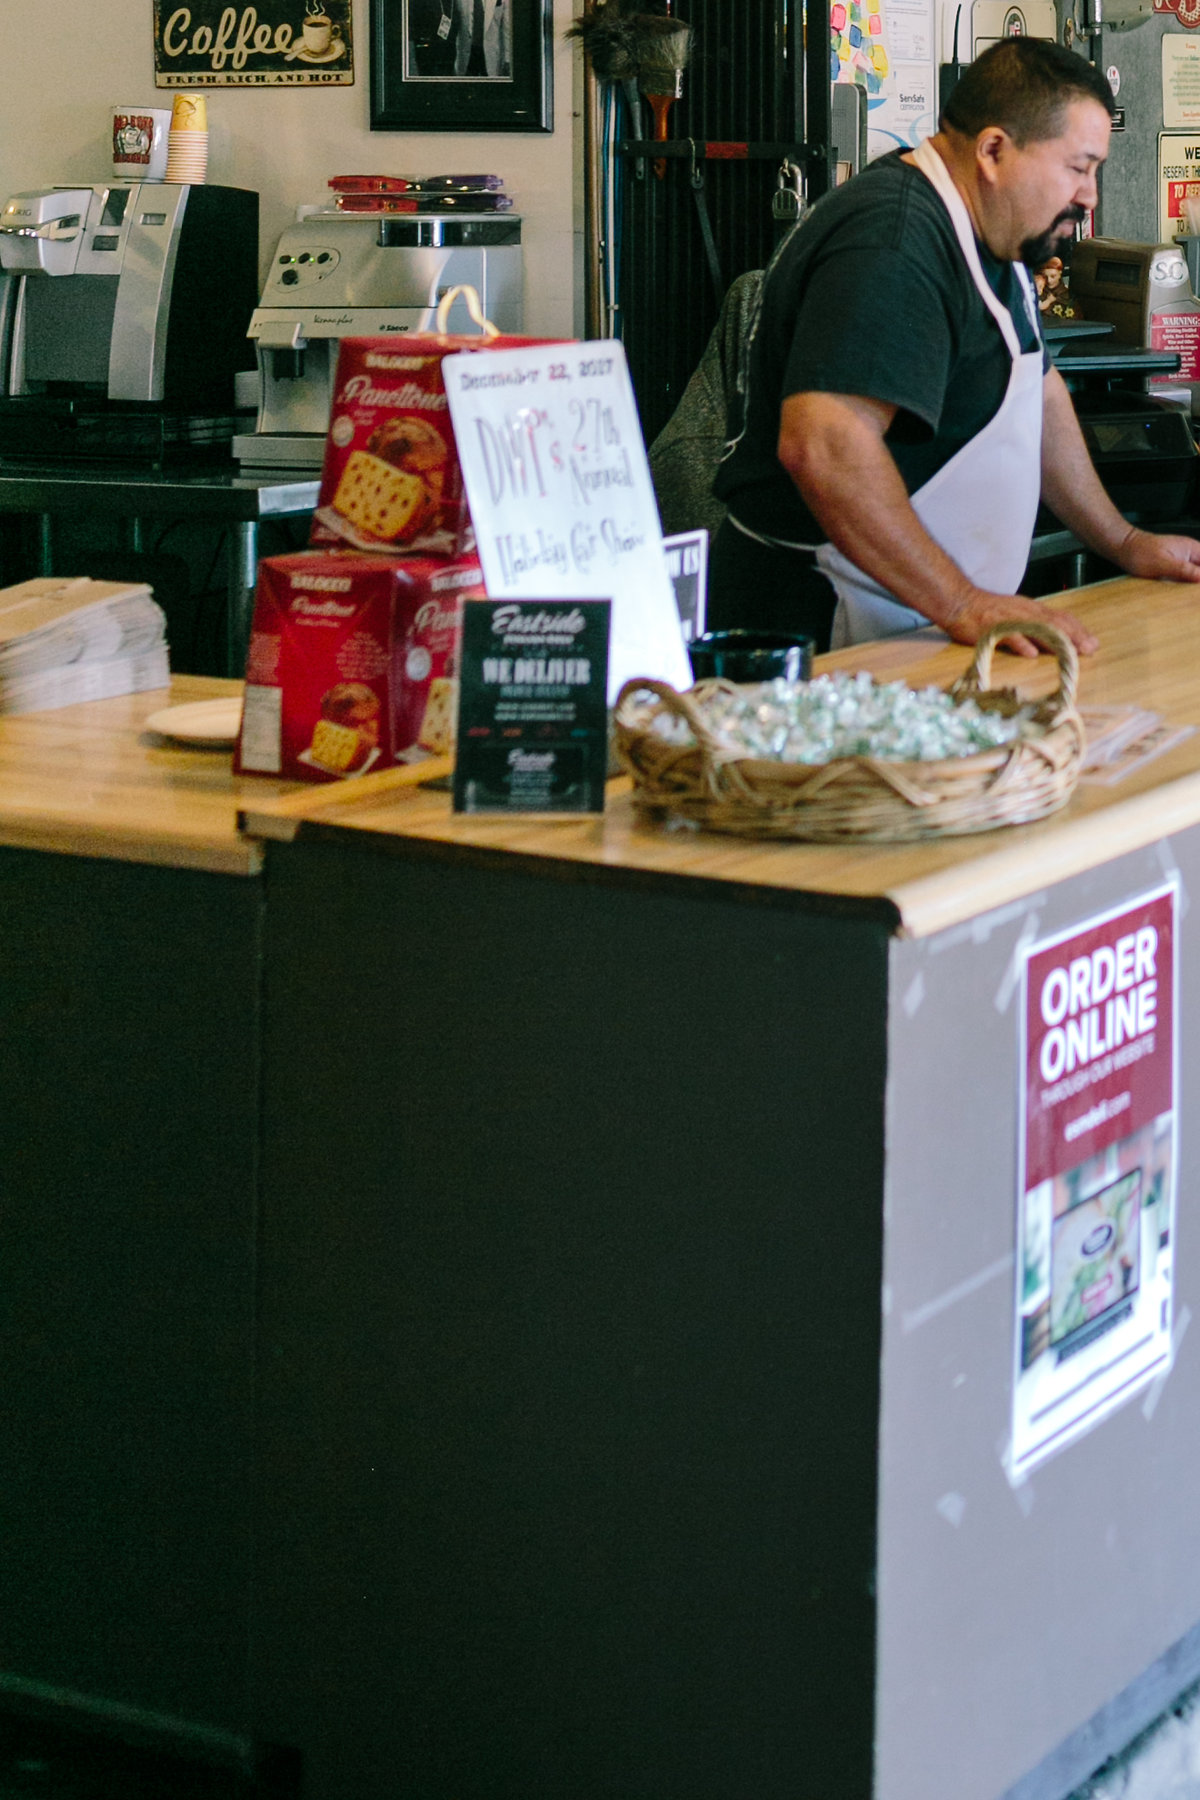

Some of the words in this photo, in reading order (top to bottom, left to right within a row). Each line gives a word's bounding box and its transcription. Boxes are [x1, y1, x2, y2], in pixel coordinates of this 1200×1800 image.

[164, 6, 294, 69] Coffee
[274, 74, 305, 82] AND
[309, 73, 344, 82] HOT
[1185, 147, 1200, 160] WE
[1163, 165, 1189, 178] RESERVE
[1174, 184, 1184, 198] TO
[1177, 220, 1184, 232] TO
[1162, 317, 1200, 325] WARNING:
[461, 369, 539, 392] December
[579, 358, 614, 377] 2017
[1041, 925, 1158, 1026] ORDER
[1040, 978, 1158, 1083] ONLINE
